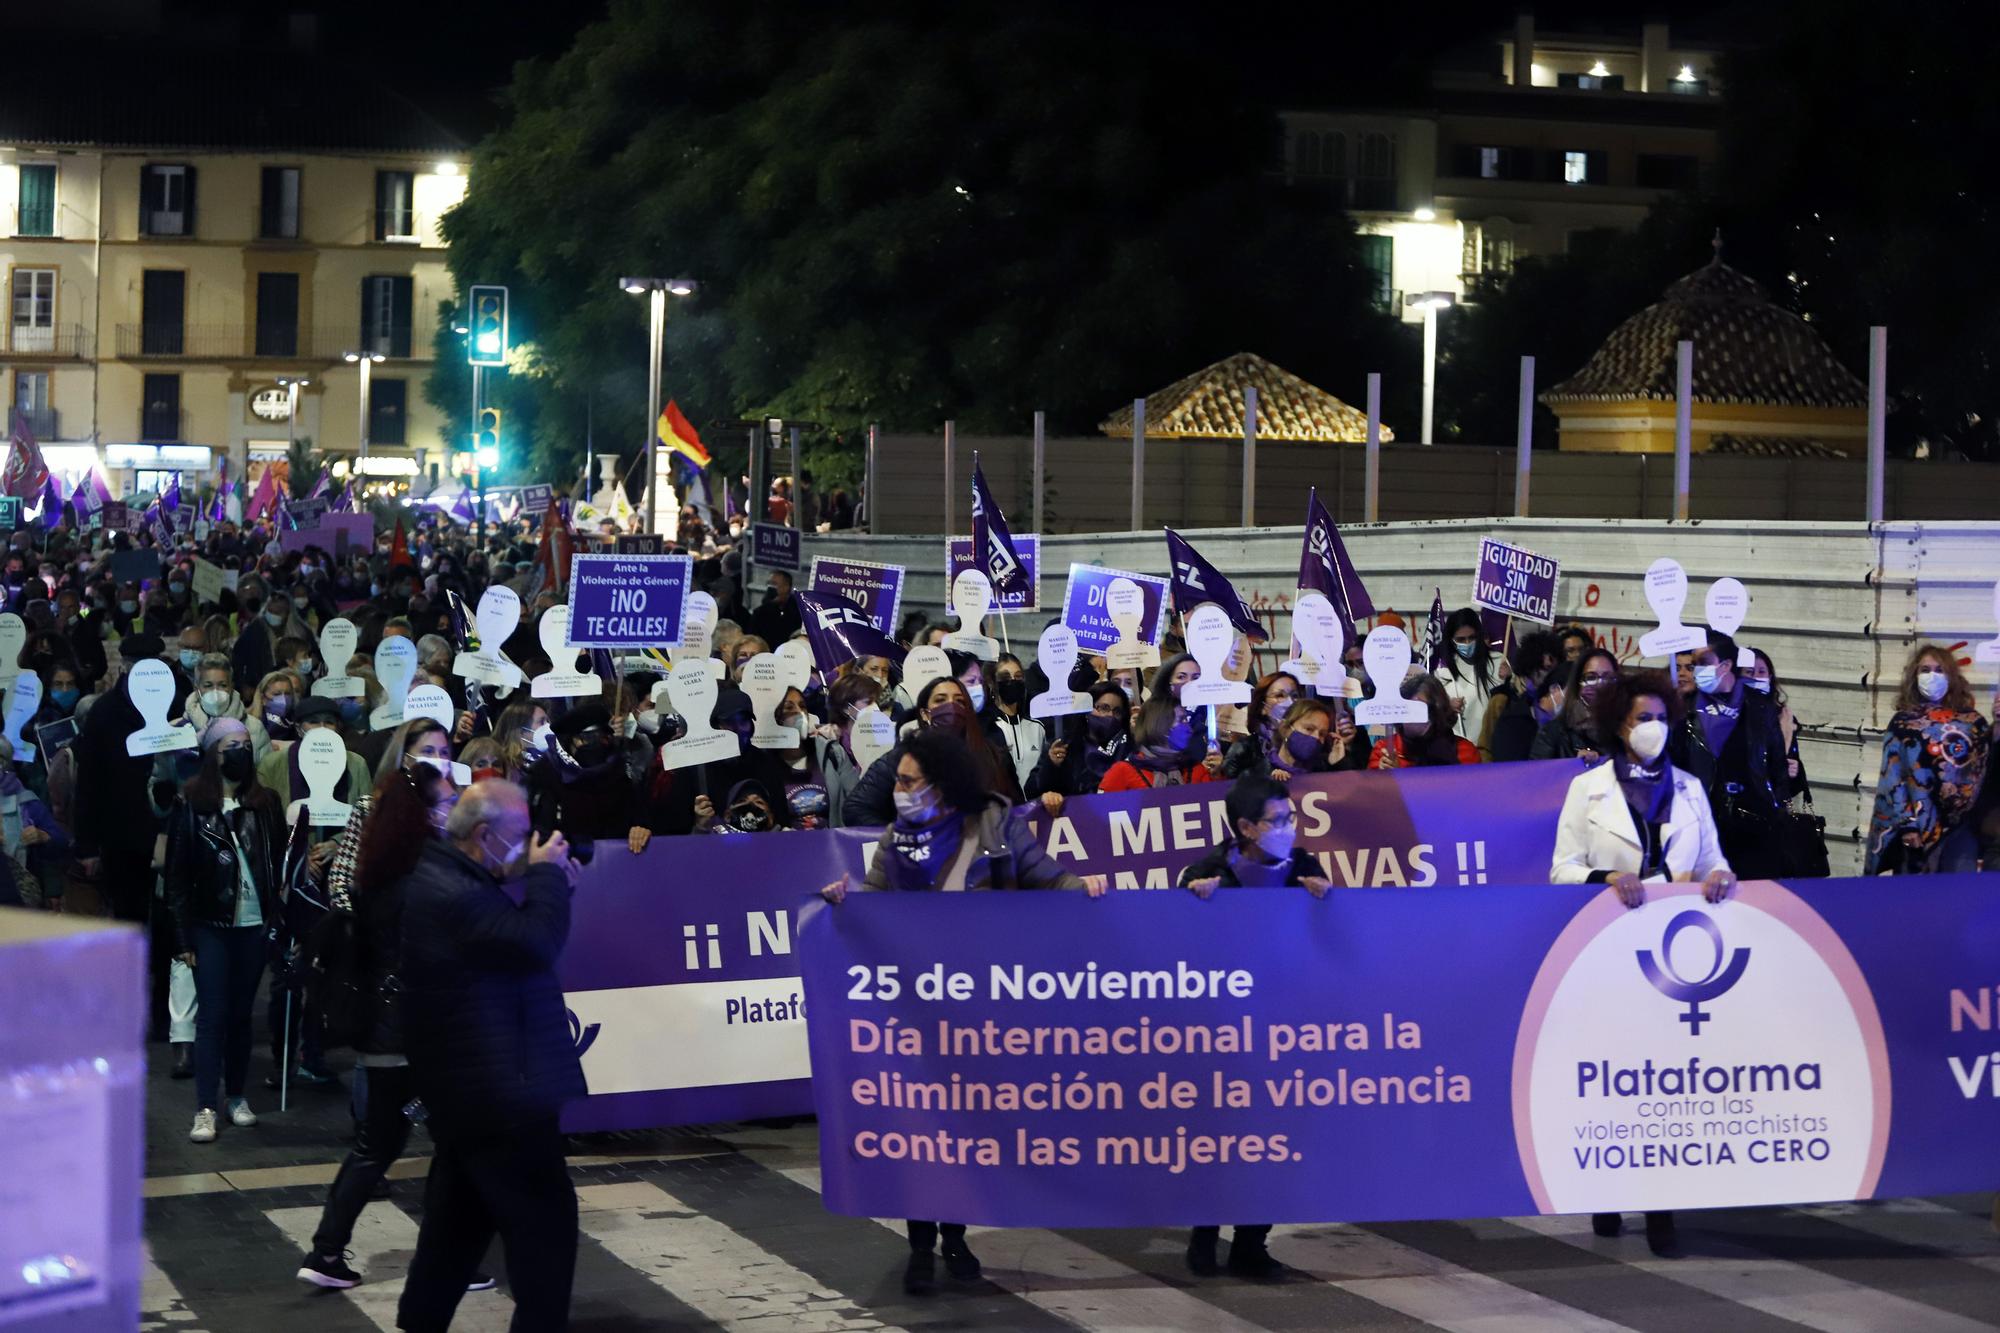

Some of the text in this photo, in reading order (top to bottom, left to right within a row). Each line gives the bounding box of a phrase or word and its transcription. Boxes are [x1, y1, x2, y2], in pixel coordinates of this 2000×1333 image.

[775, 531, 791, 547] NO
[613, 563, 648, 573] Ante la
[843, 566, 871, 576] Ante la
[1485, 543, 1553, 579] IGUALDAD
[582, 575, 680, 585] Violencia de Género
[819, 574, 894, 590] Violencia de Género
[1505, 569, 1528, 591] SIN
[610, 588, 647, 613] ¡NO
[1087, 584, 1105, 607] DI
[1480, 580, 1548, 617] VIOLENCIA
[586, 617, 668, 636] TE CALLES!
[1080, 614, 1087, 623] A
[1089, 615, 1098, 625] la
[1072, 629, 1112, 642] ontra las
[1108, 791, 1332, 857] MENS
[1312, 843, 1438, 888] IVAS
[746, 910, 800, 956] N
[847, 961, 1254, 1001] 25 de Noviembre
[850, 1013, 1422, 1061] Día Internacional para la
[851, 1066, 1471, 1112] eliminación de la violencia
[1576, 1057, 1822, 1098] Plataforma
[1637, 1095, 1754, 1119] contra las
[1574, 1114, 1828, 1141] violencias machistas
[853, 1126, 1303, 1174] contra las mujeres.
[1574, 1138, 1831, 1171] VIOLENCIA CERO
